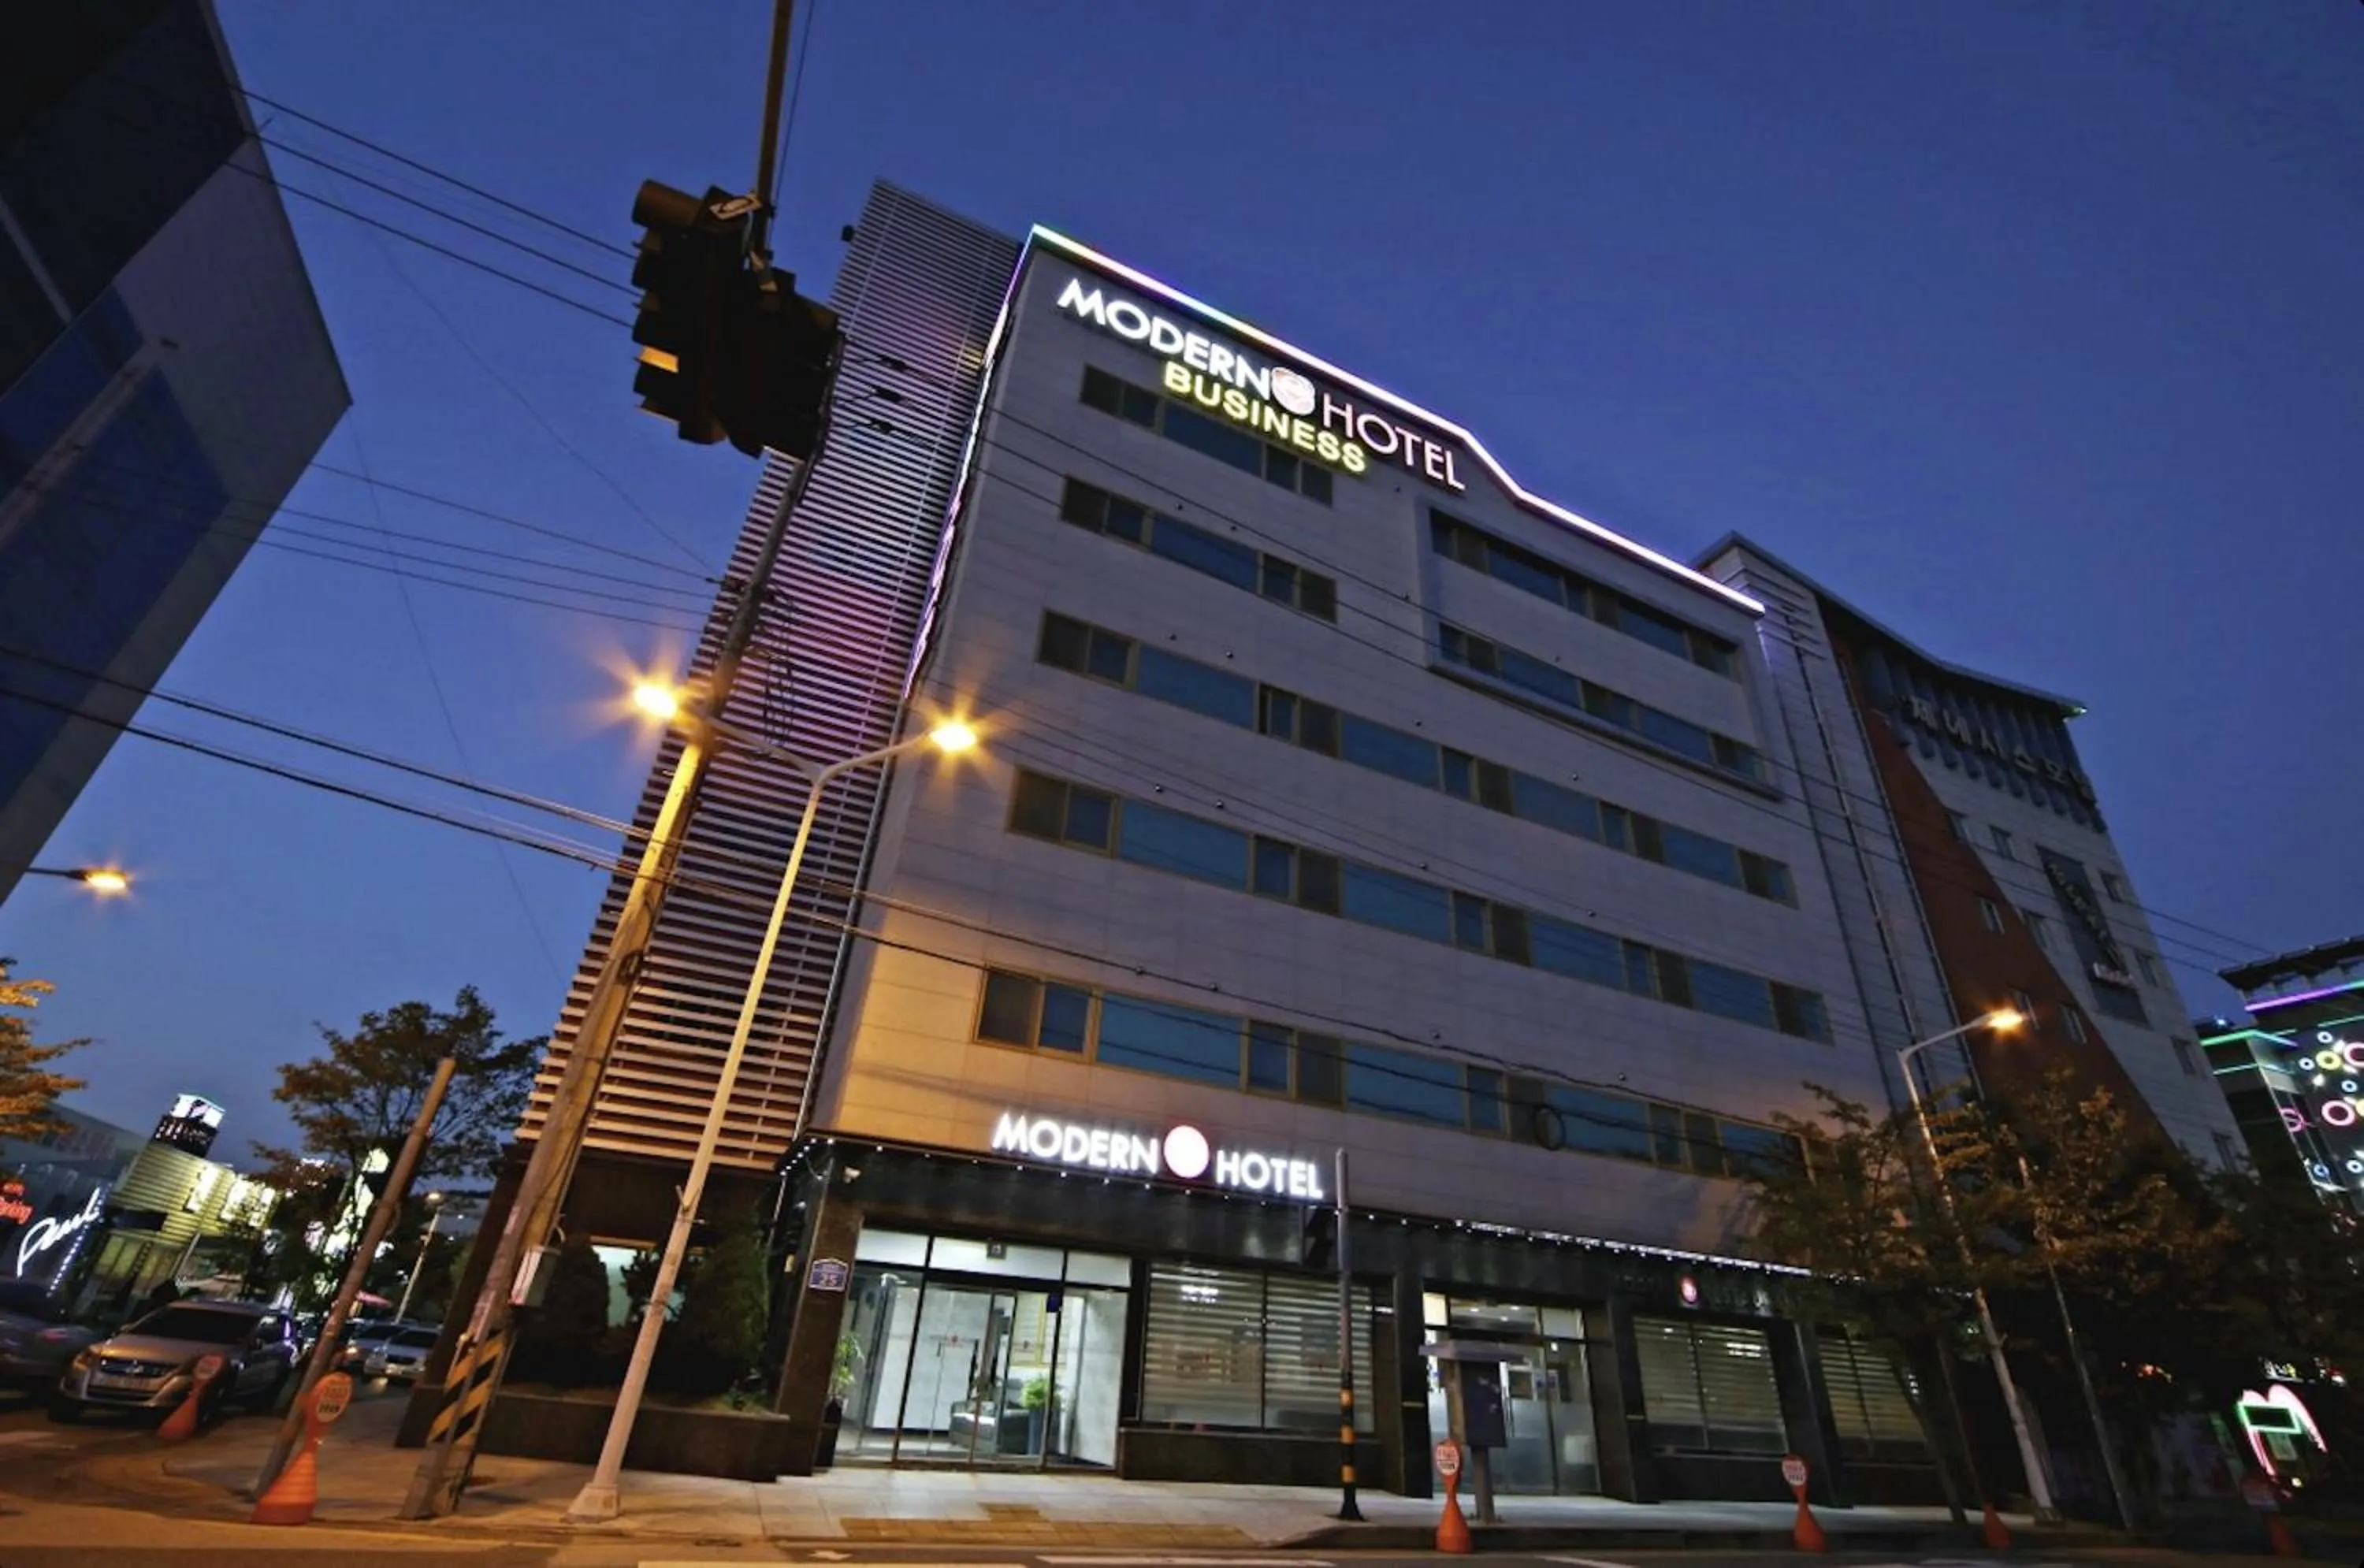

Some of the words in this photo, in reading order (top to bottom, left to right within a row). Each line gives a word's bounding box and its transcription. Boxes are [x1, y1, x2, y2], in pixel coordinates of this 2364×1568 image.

[1057, 279, 1269, 399] MODERN
[1321, 392, 1466, 491] HOTEL
[1164, 362, 1367, 473] BUSINESS
[993, 1113, 1158, 1172] MODERN
[1215, 1150, 1323, 1198] HOTEL
